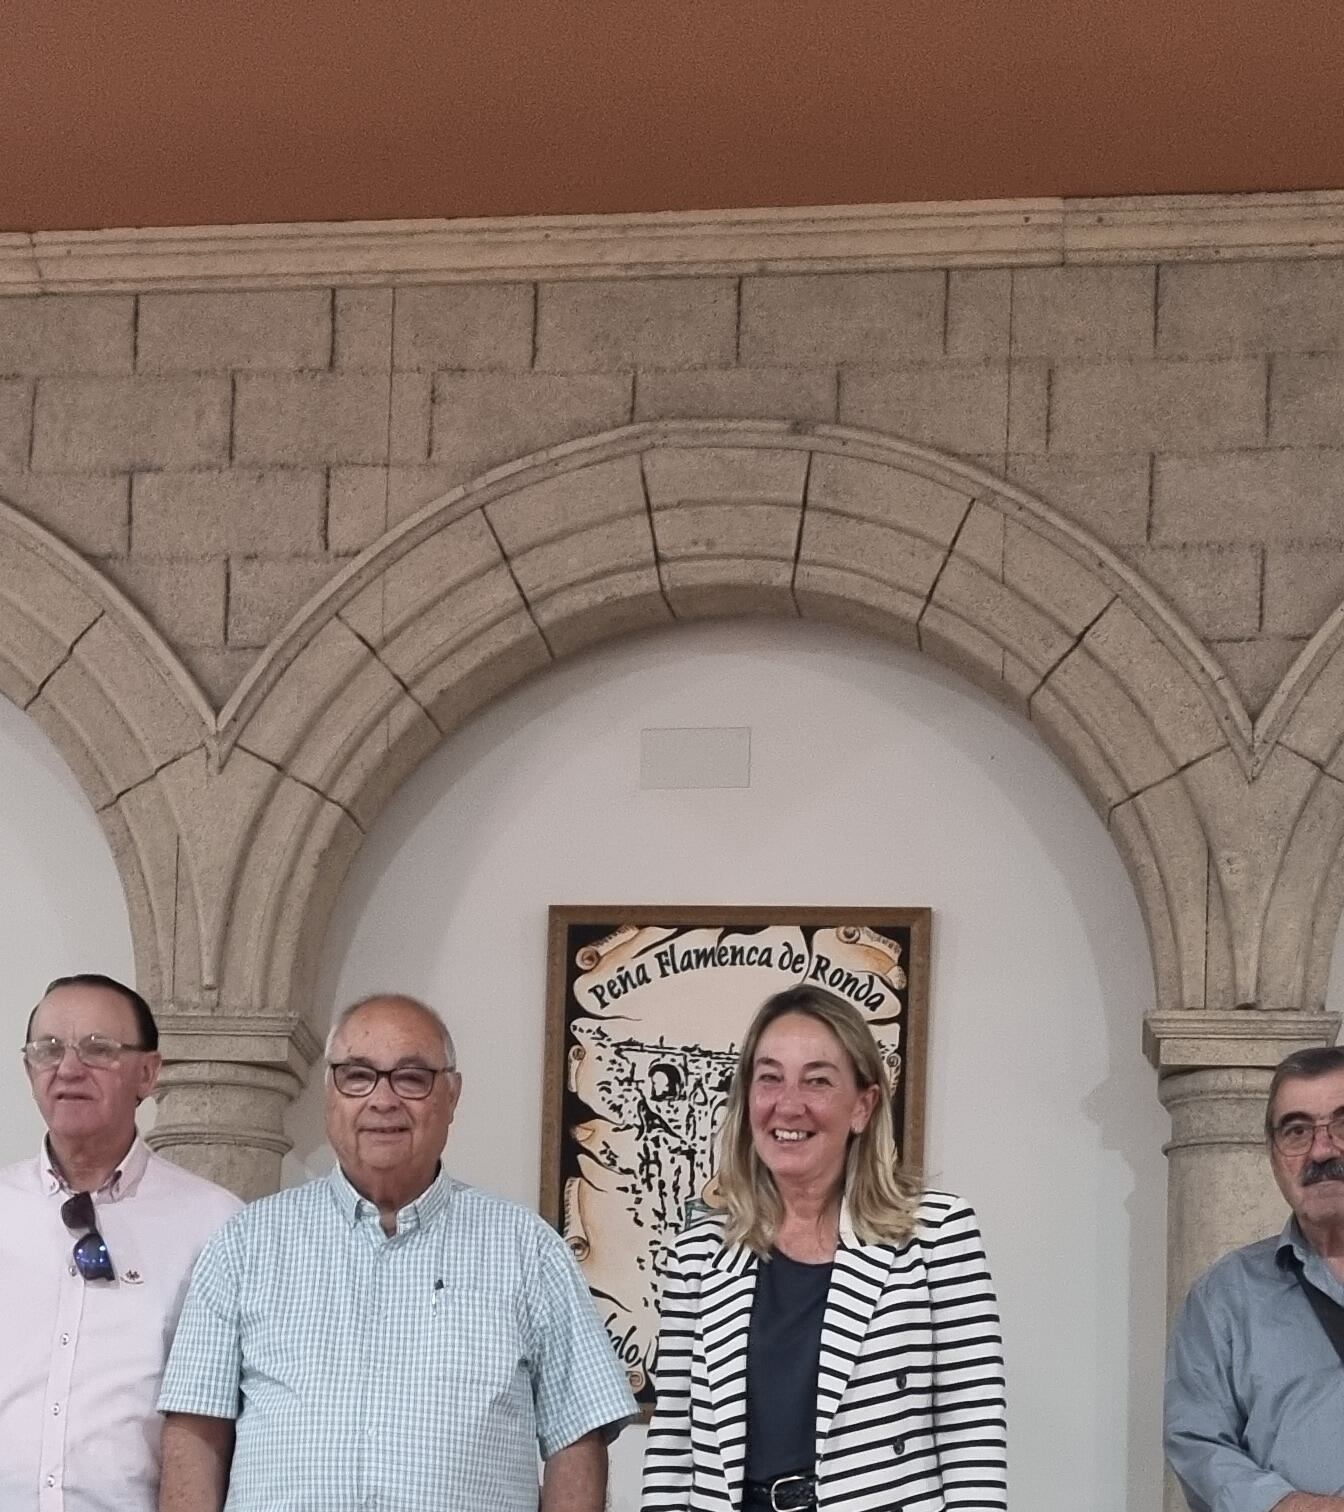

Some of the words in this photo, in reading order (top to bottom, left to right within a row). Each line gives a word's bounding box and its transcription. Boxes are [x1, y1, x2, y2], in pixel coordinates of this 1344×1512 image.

[587, 964, 652, 1010] Peña
[654, 942, 774, 981] Flamenca
[777, 941, 805, 973] de
[809, 954, 886, 1013] Ronda
